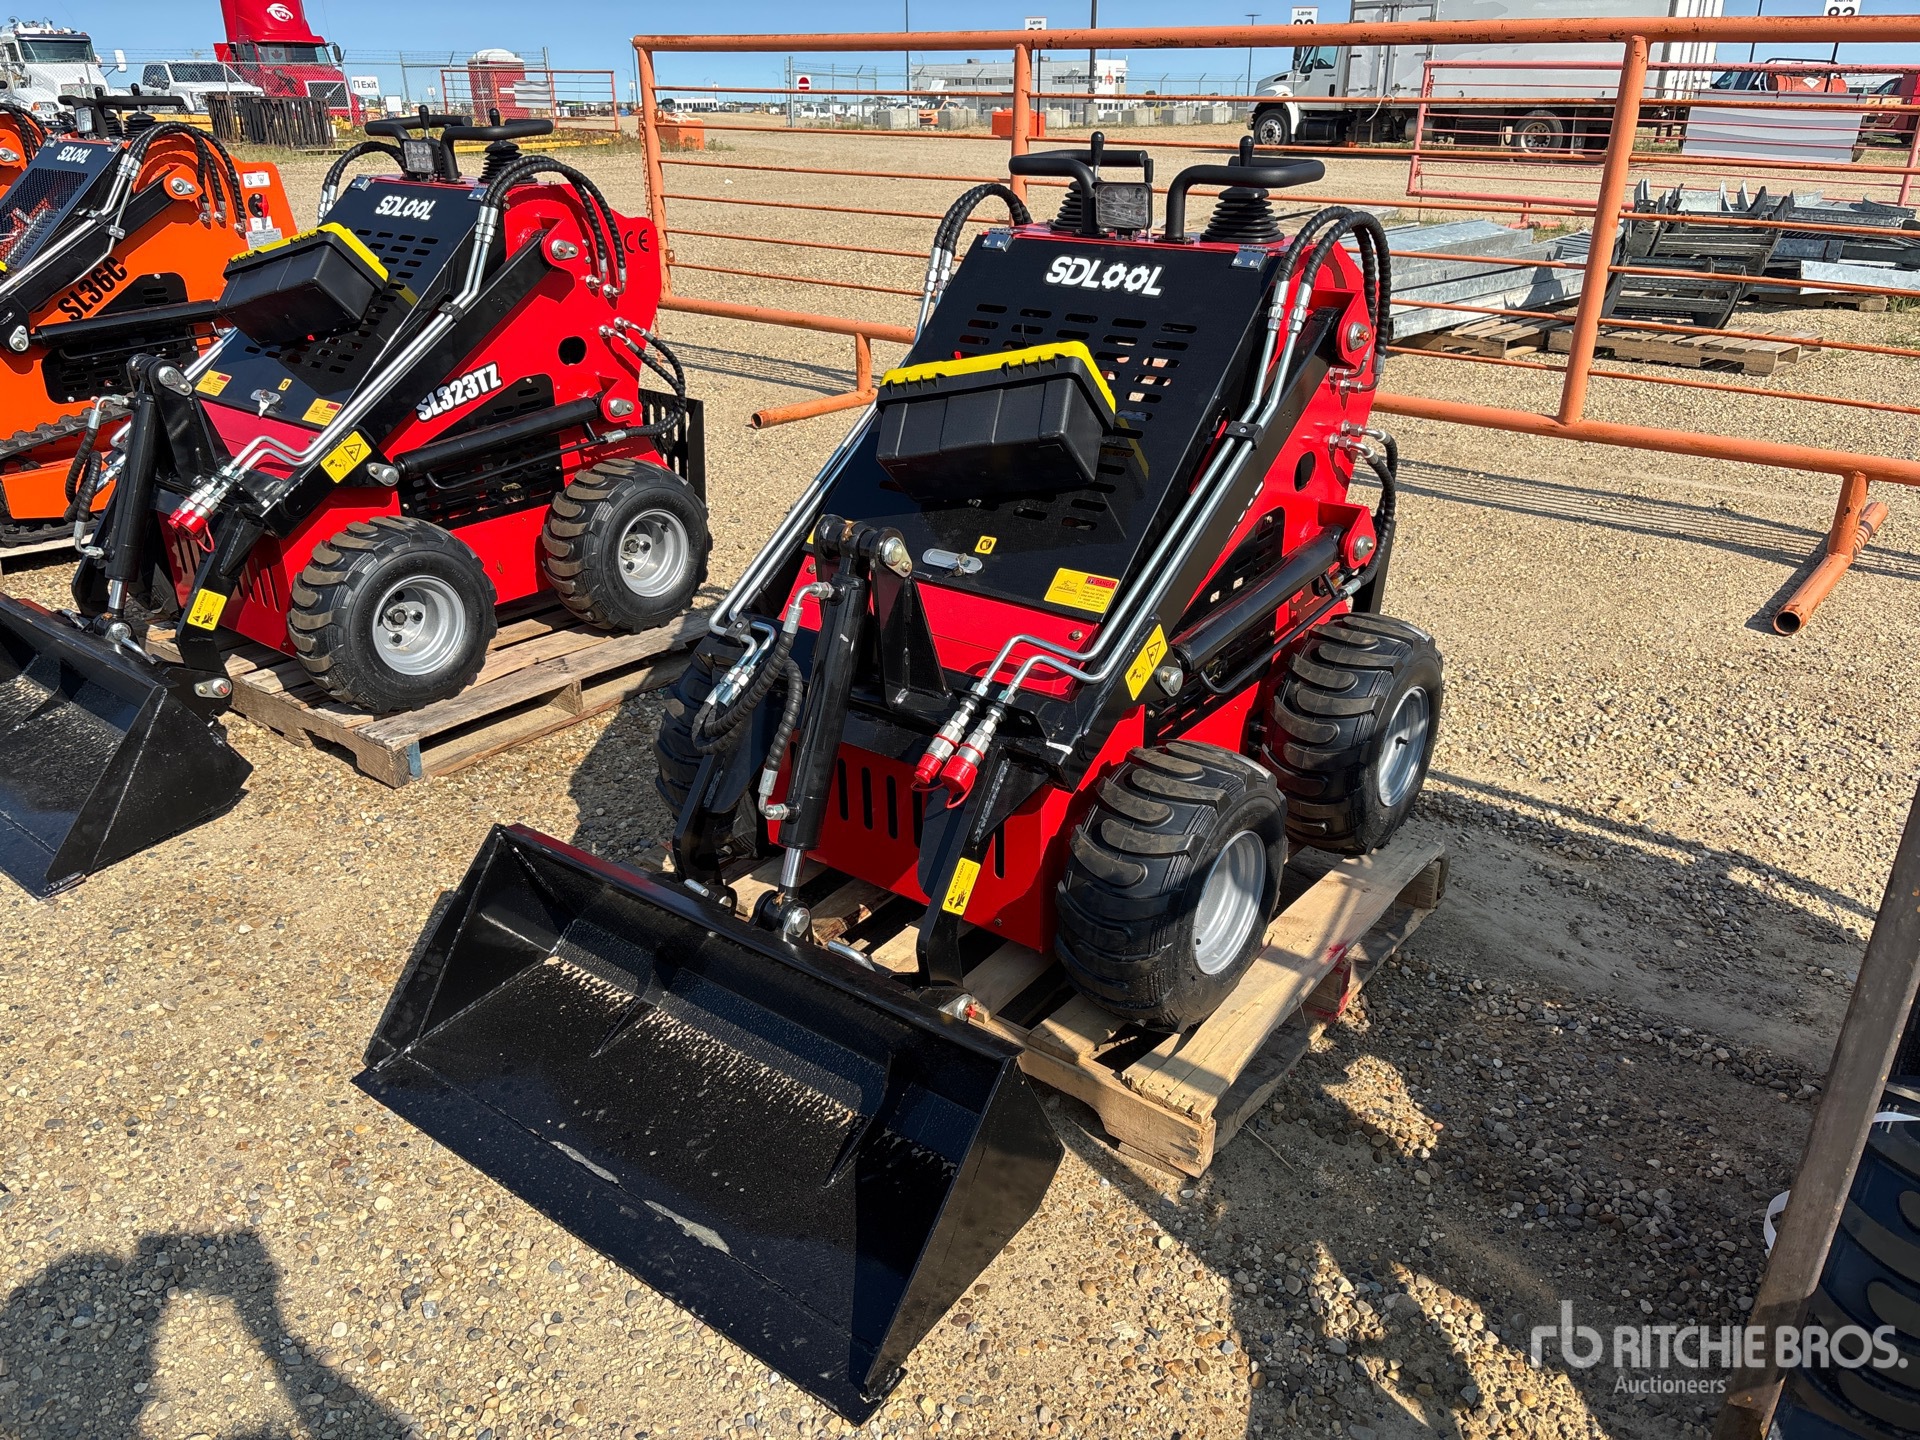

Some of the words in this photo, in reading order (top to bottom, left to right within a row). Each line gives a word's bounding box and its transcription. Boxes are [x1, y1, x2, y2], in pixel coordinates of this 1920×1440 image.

[361, 80, 377, 88] Exit
[375, 195, 437, 221] SDLOOL
[624, 229, 650, 254] CE
[58, 256, 128, 321] SL36C
[1044, 255, 1164, 297] SDLOOL
[414, 362, 503, 421] SL323TZ
[197, 593, 208, 614] CAUTION
[952, 862, 966, 894] CAUTION
